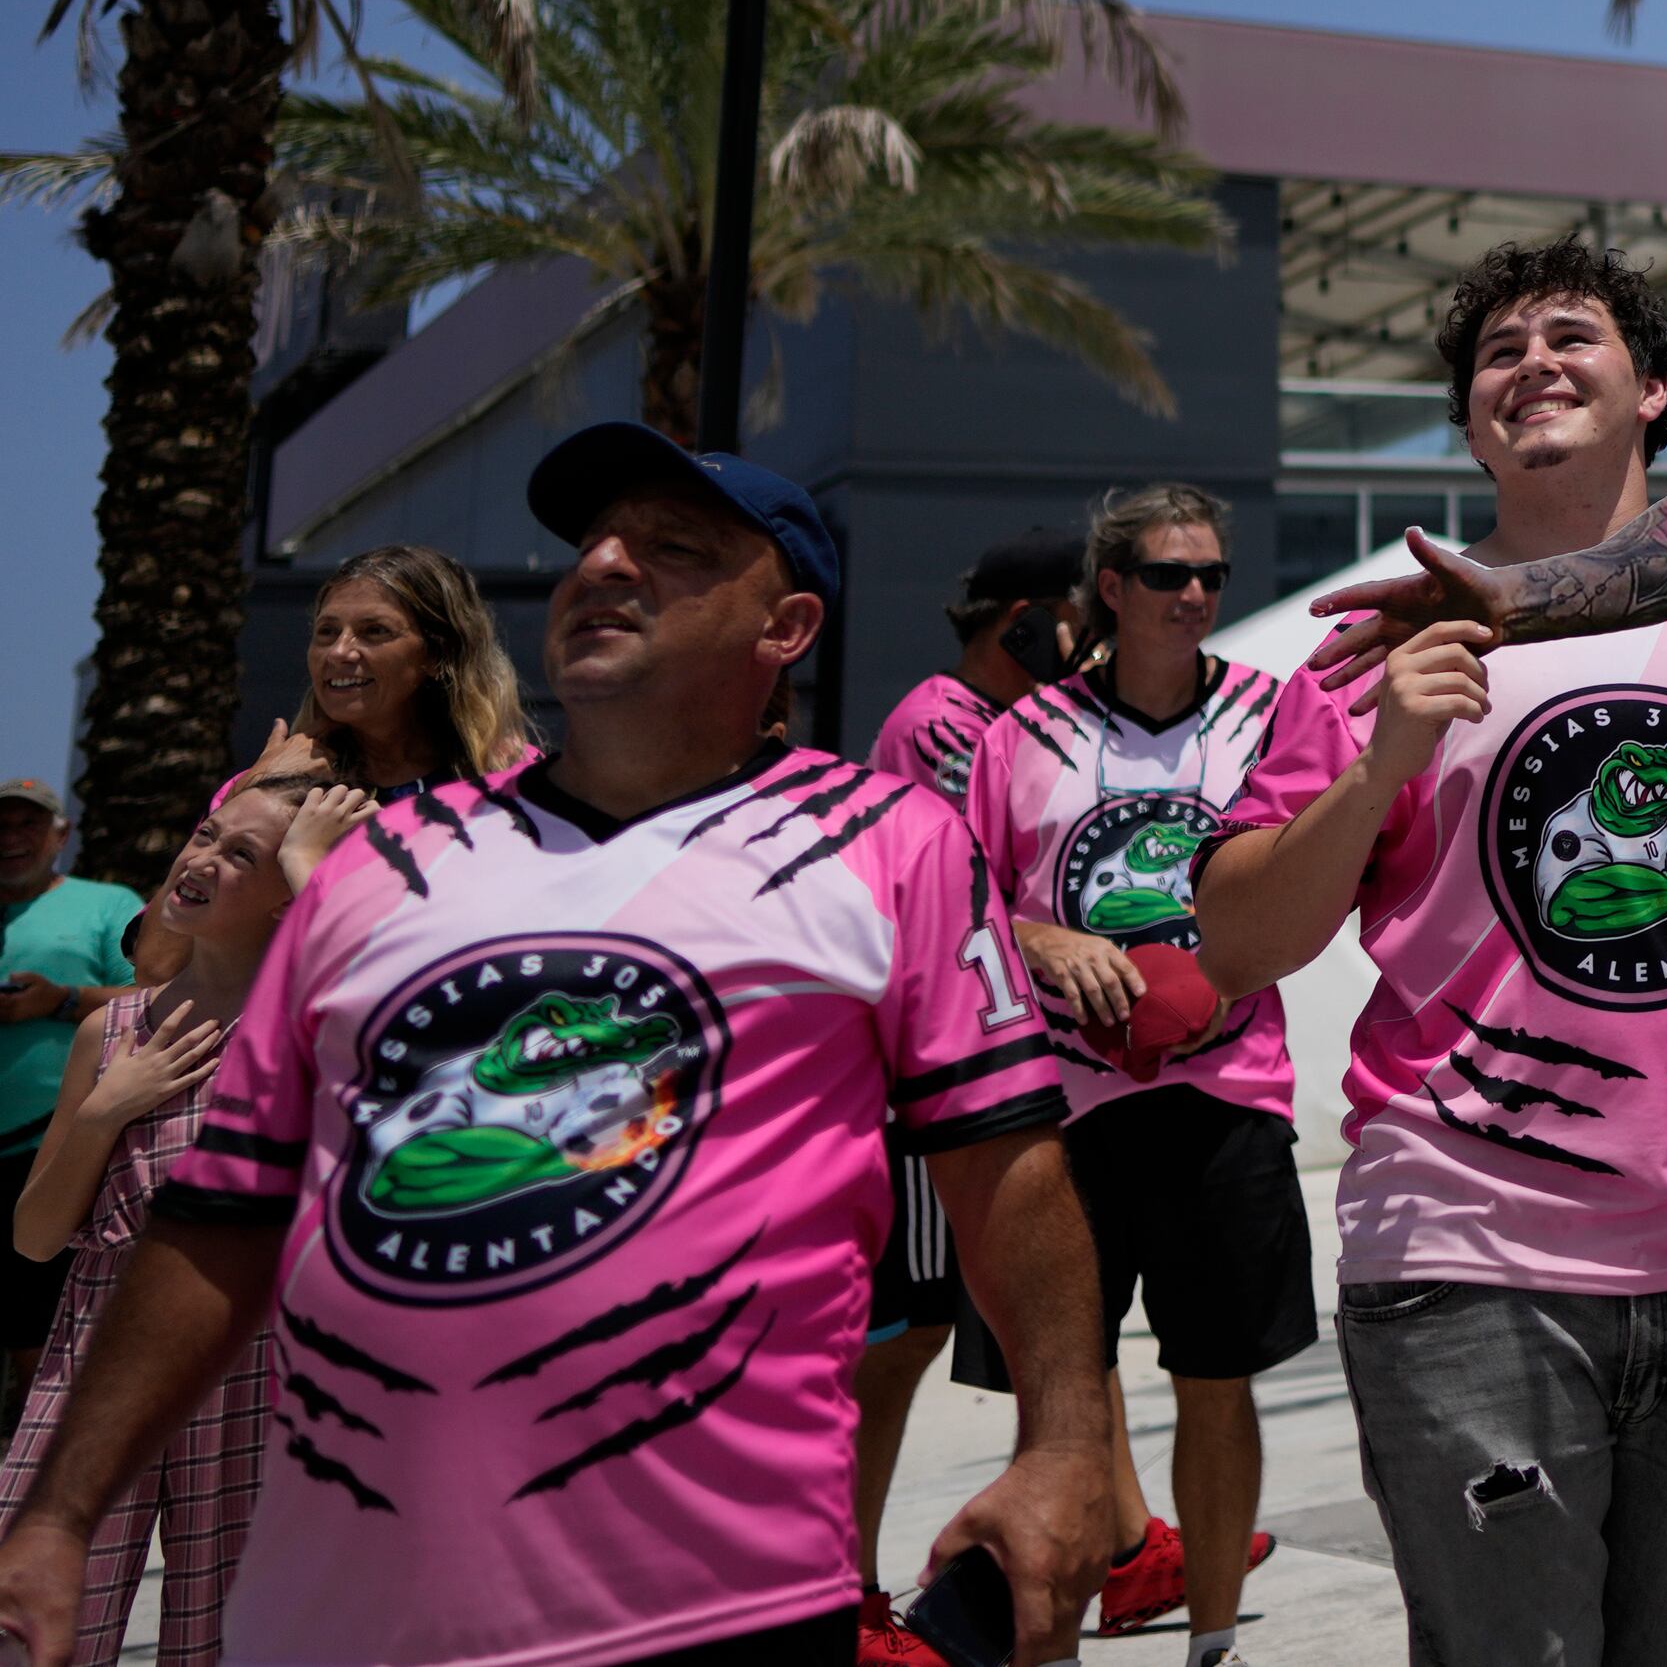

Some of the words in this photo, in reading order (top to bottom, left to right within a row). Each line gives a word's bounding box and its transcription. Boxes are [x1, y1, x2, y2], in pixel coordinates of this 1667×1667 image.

[1066, 802, 1149, 893] MESSIAS
[1168, 803, 1210, 831] 305
[1509, 707, 1612, 869] MESSIAS
[1643, 840, 1659, 860] 10
[352, 954, 545, 1125] MESSIAS
[582, 955, 667, 1008] 305
[522, 1100, 545, 1125] 10
[376, 1114, 684, 1274] ALENTANDO
